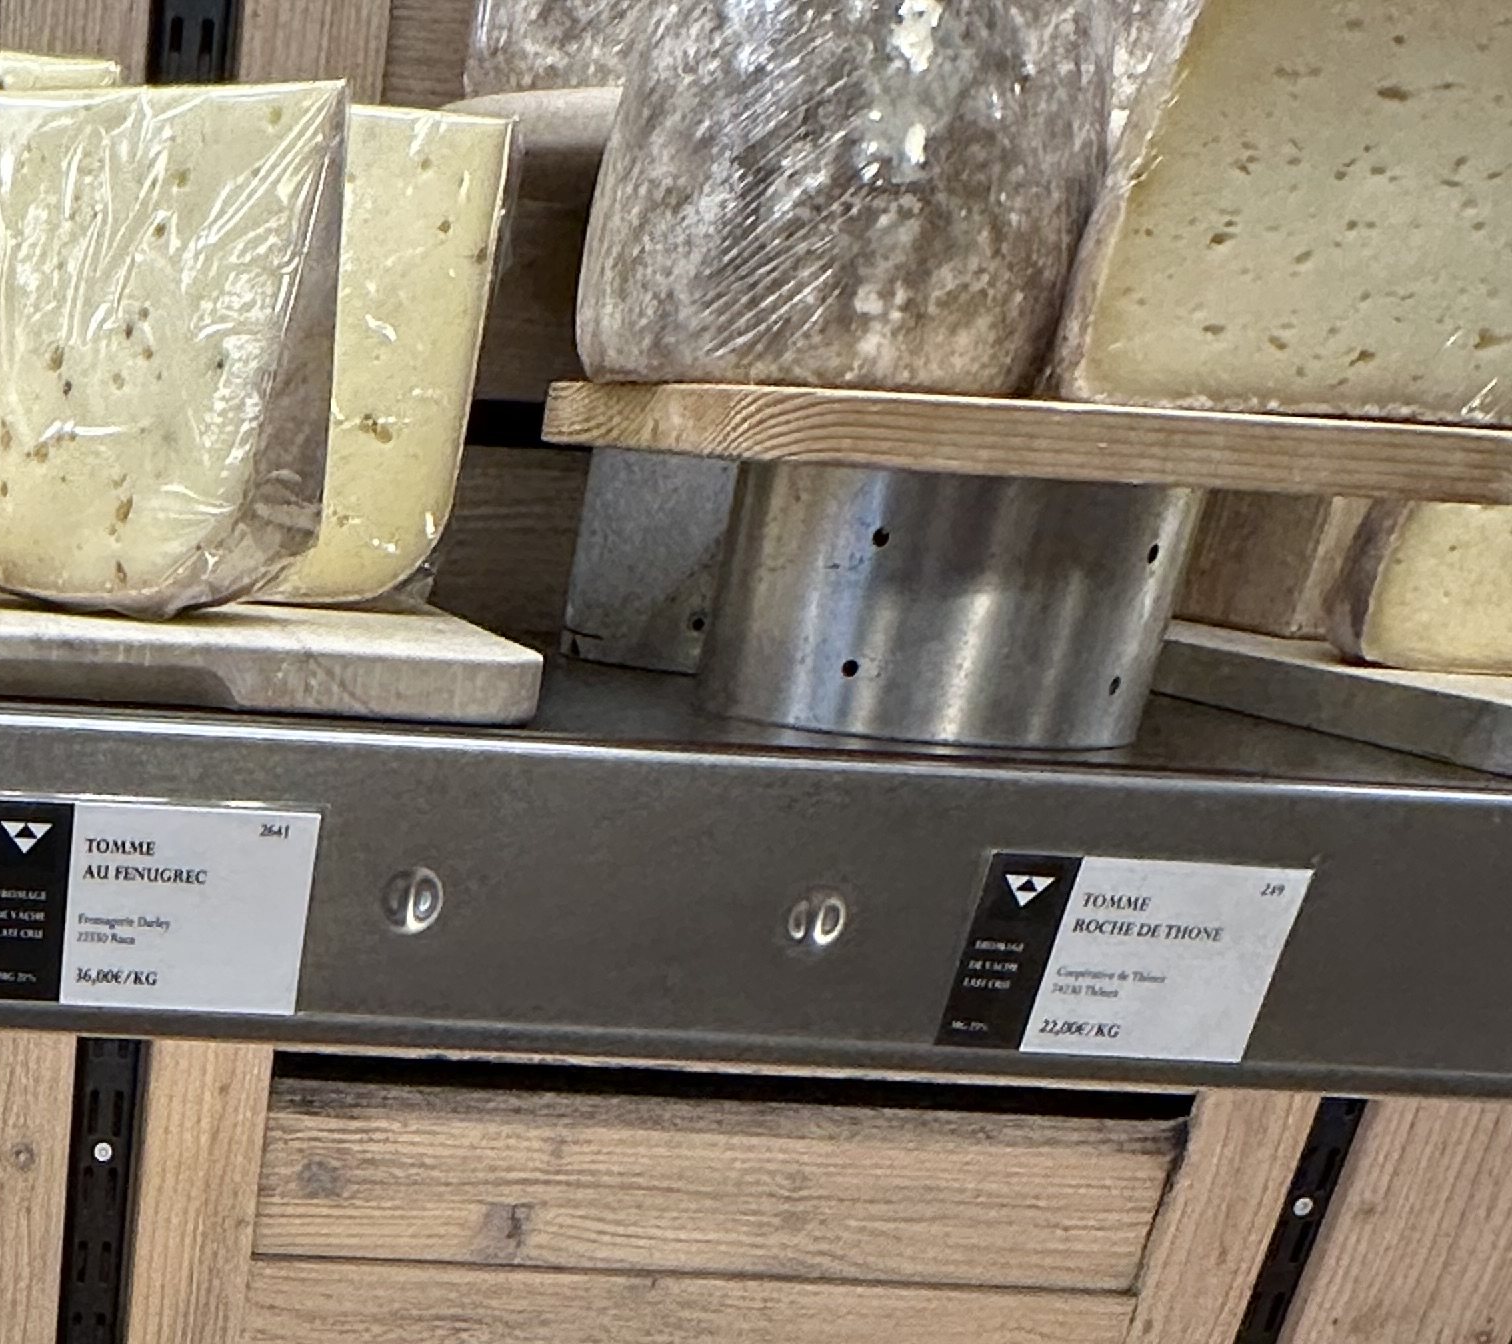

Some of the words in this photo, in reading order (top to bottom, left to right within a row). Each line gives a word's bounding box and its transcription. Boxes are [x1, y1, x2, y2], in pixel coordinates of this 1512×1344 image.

[85, 838, 156, 857] TOMME
[83, 865, 109, 880] AU
[114, 866, 208, 886] FENUGREC
[1082, 892, 1152, 912] TOMME
[1072, 918, 1136, 937] ROCHE
[1137, 922, 1161, 939] DE
[76, 968, 158, 987] 36,00€/KG
